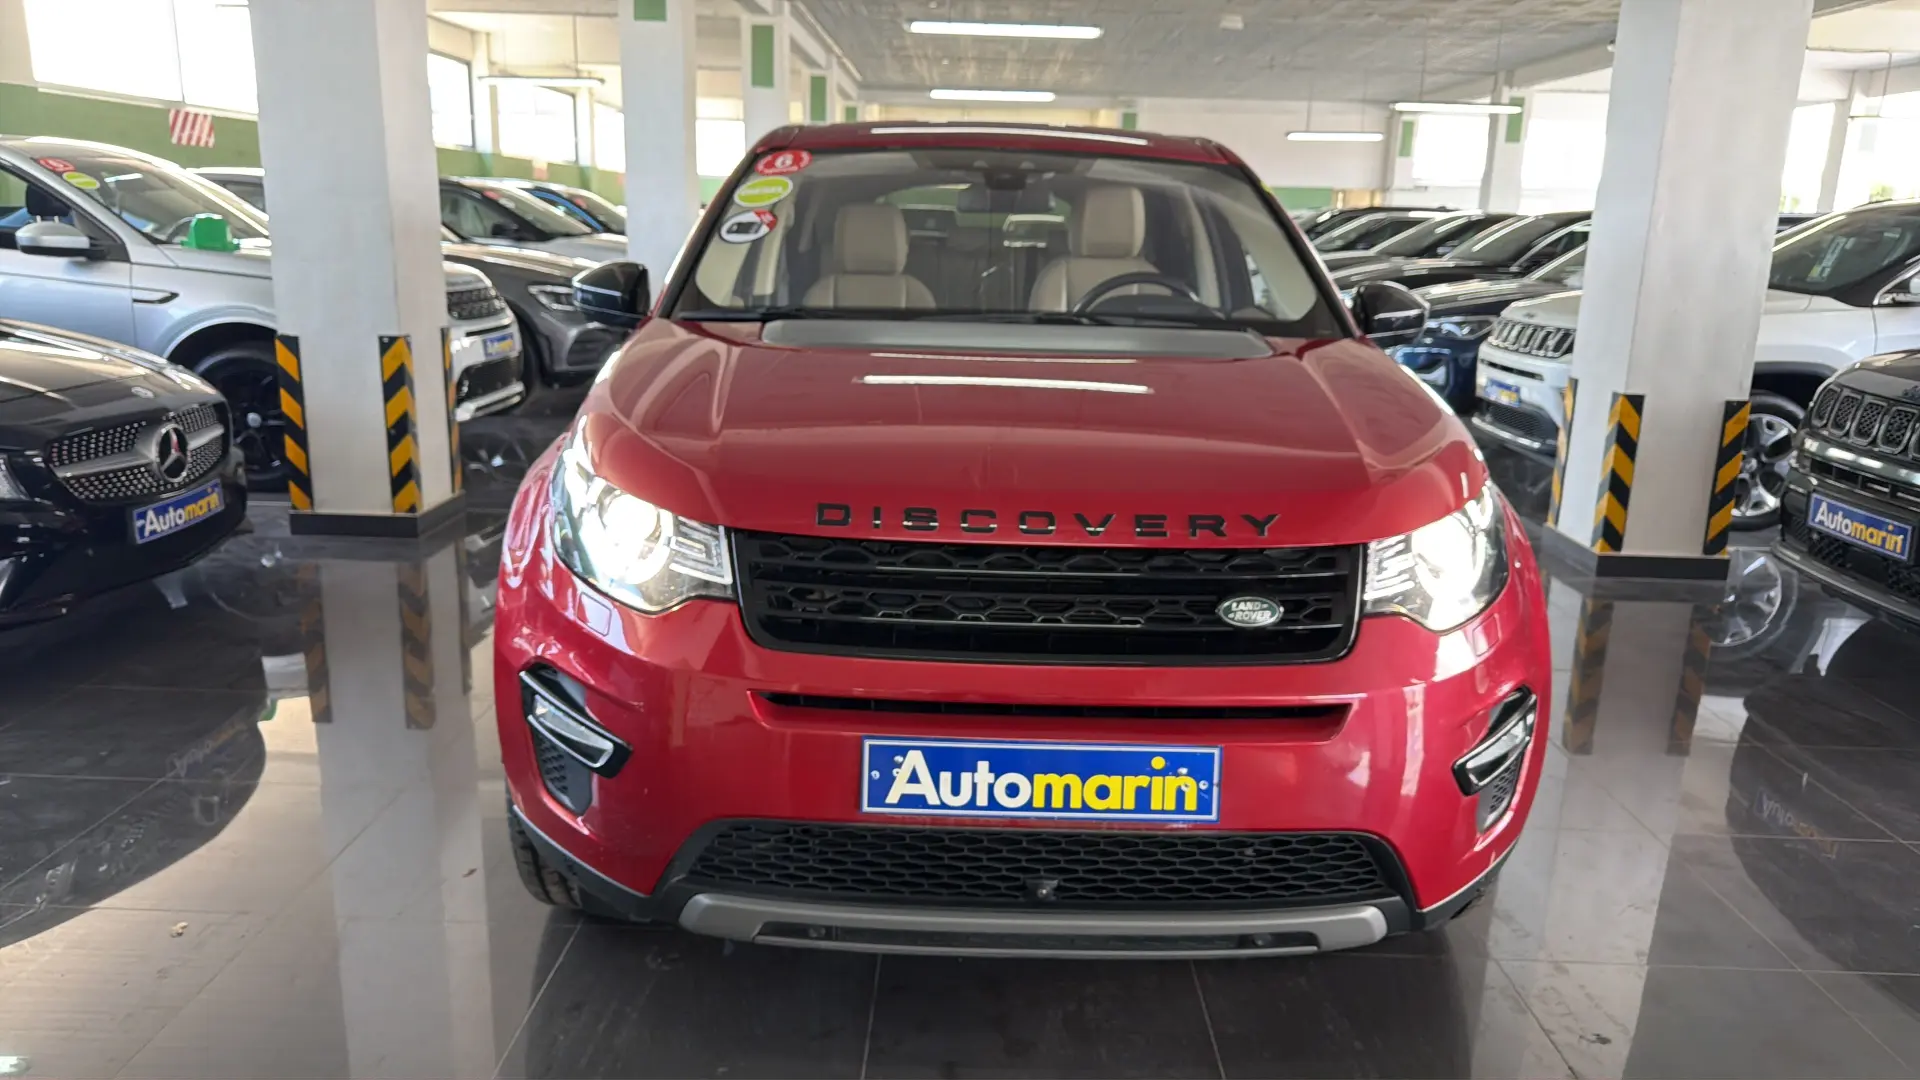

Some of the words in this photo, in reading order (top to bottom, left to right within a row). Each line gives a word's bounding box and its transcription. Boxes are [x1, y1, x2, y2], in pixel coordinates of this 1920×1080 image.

[816, 503, 1279, 538] DISCOVERY
[1814, 500, 1904, 553] Automarin
[884, 749, 1198, 811] Automarin
